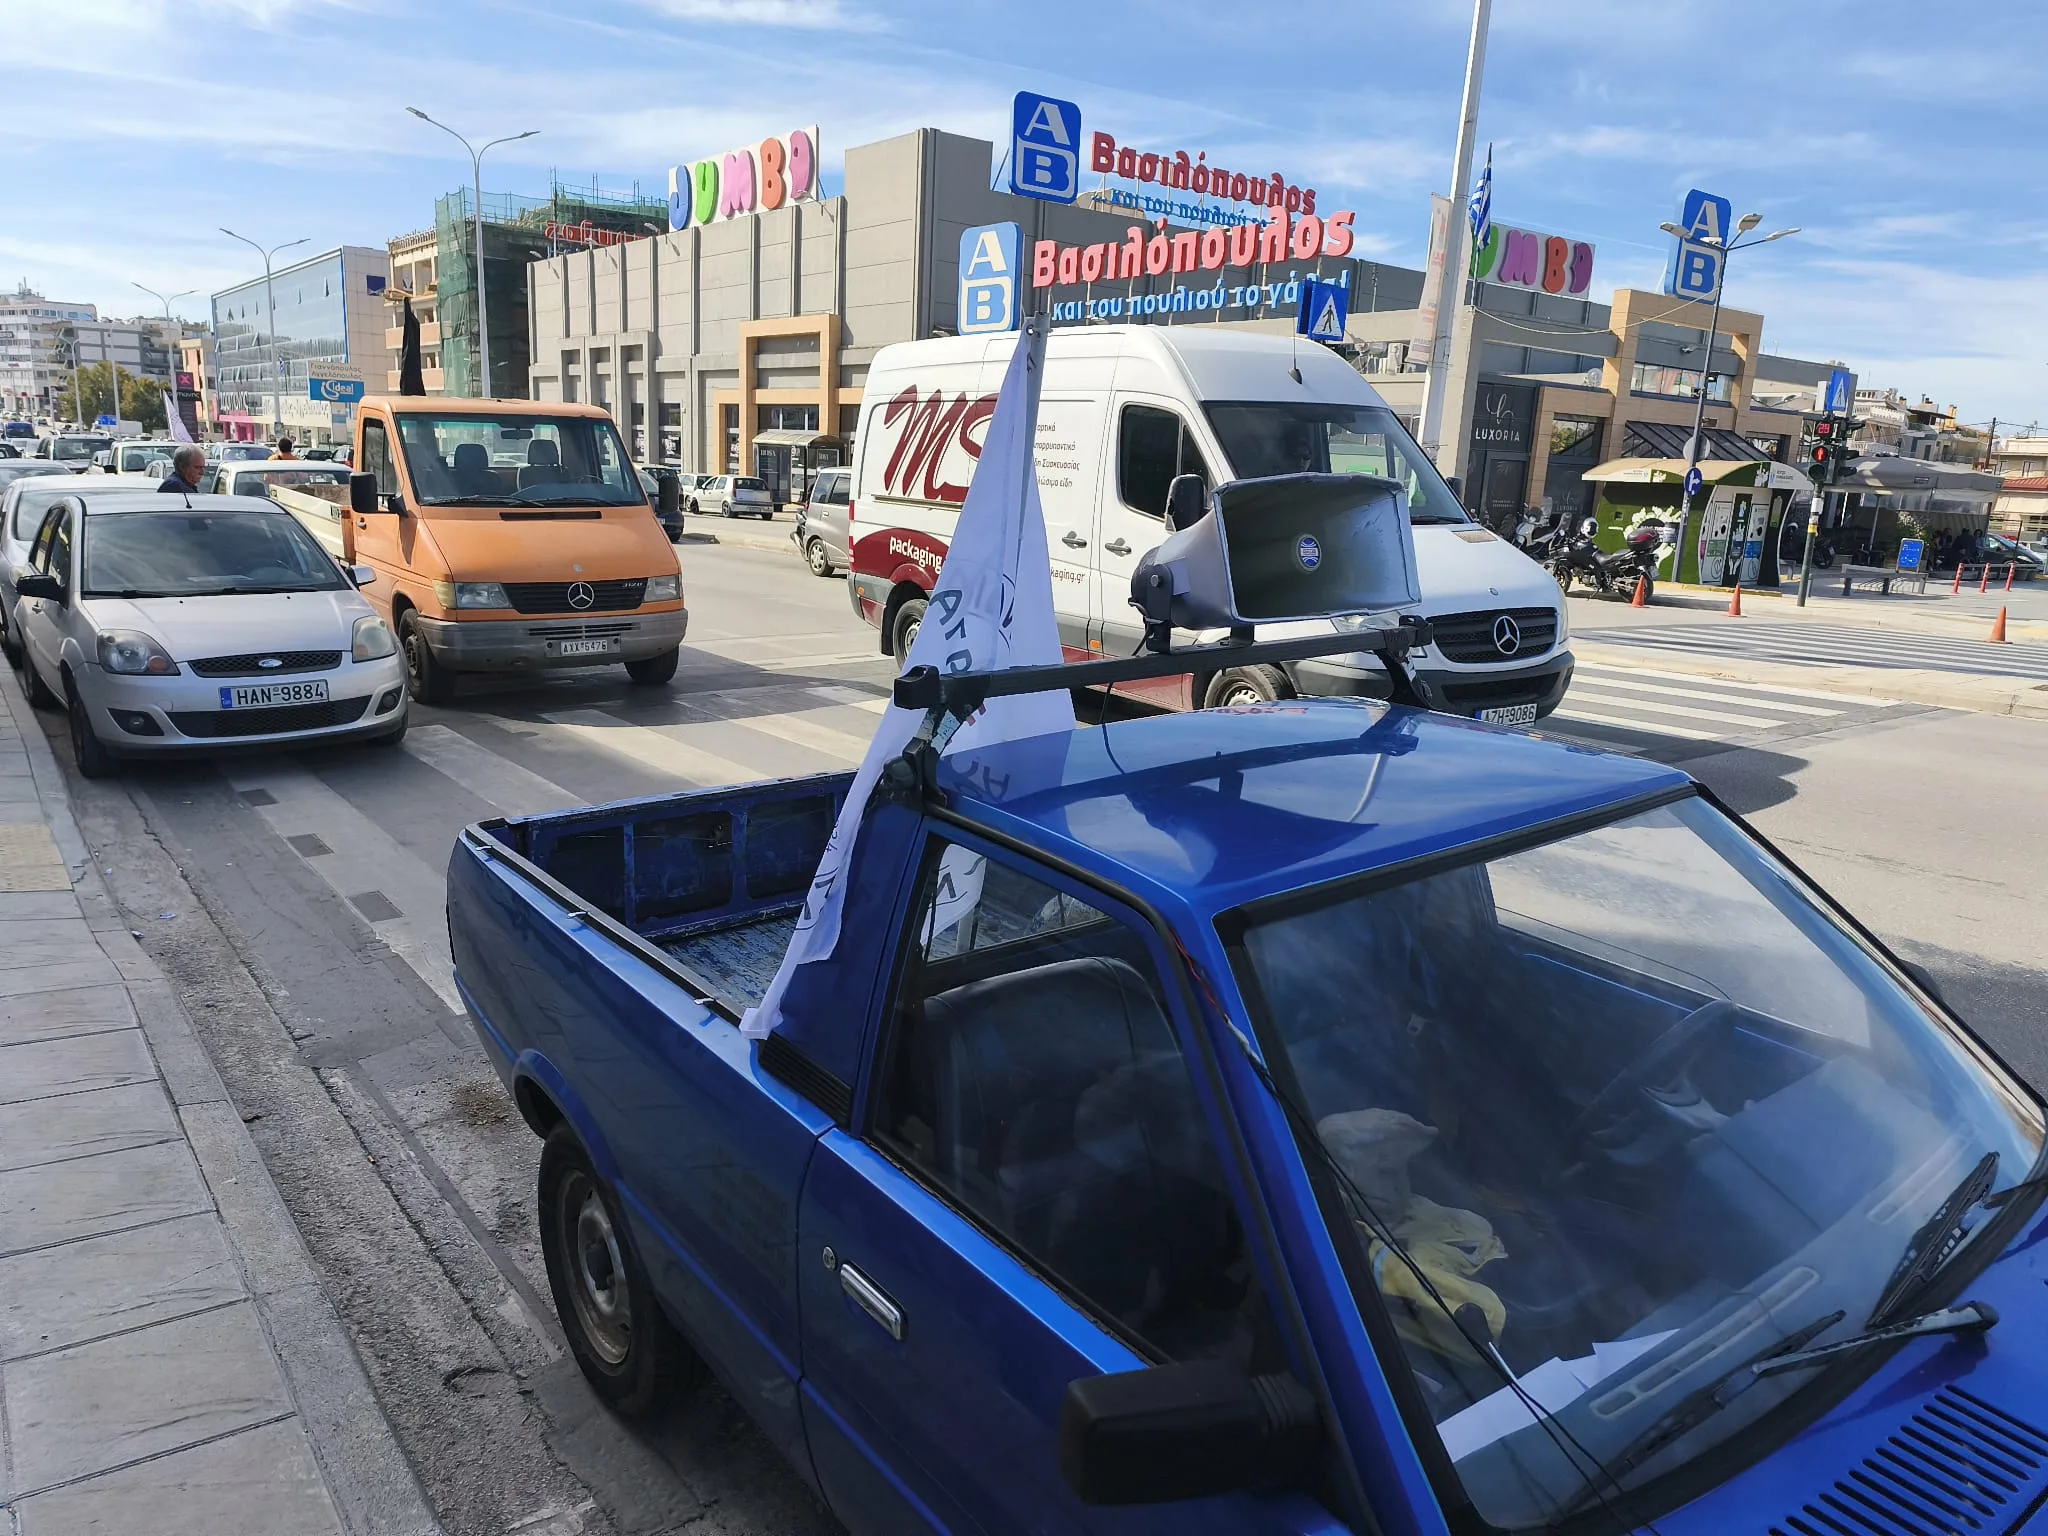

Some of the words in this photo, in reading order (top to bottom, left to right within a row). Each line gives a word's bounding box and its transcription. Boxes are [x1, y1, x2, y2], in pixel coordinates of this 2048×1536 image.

[669, 129, 814, 231] JUMBO
[1091, 131, 1317, 215] Βασιλόπουλος
[1032, 205, 1356, 288] Βασιλόπουλος
[1469, 225, 1594, 294] UMBO
[1053, 300, 1085, 321] και
[1088, 293, 1124, 318] του
[1129, 277, 1228, 315] πουλιού
[1233, 284, 1261, 308] το
[1036, 421, 1056, 433] αρτικά
[1475, 427, 1520, 442] LUXORIA
[889, 535, 943, 575] packaging
[1050, 566, 1086, 584] kaging.gr
